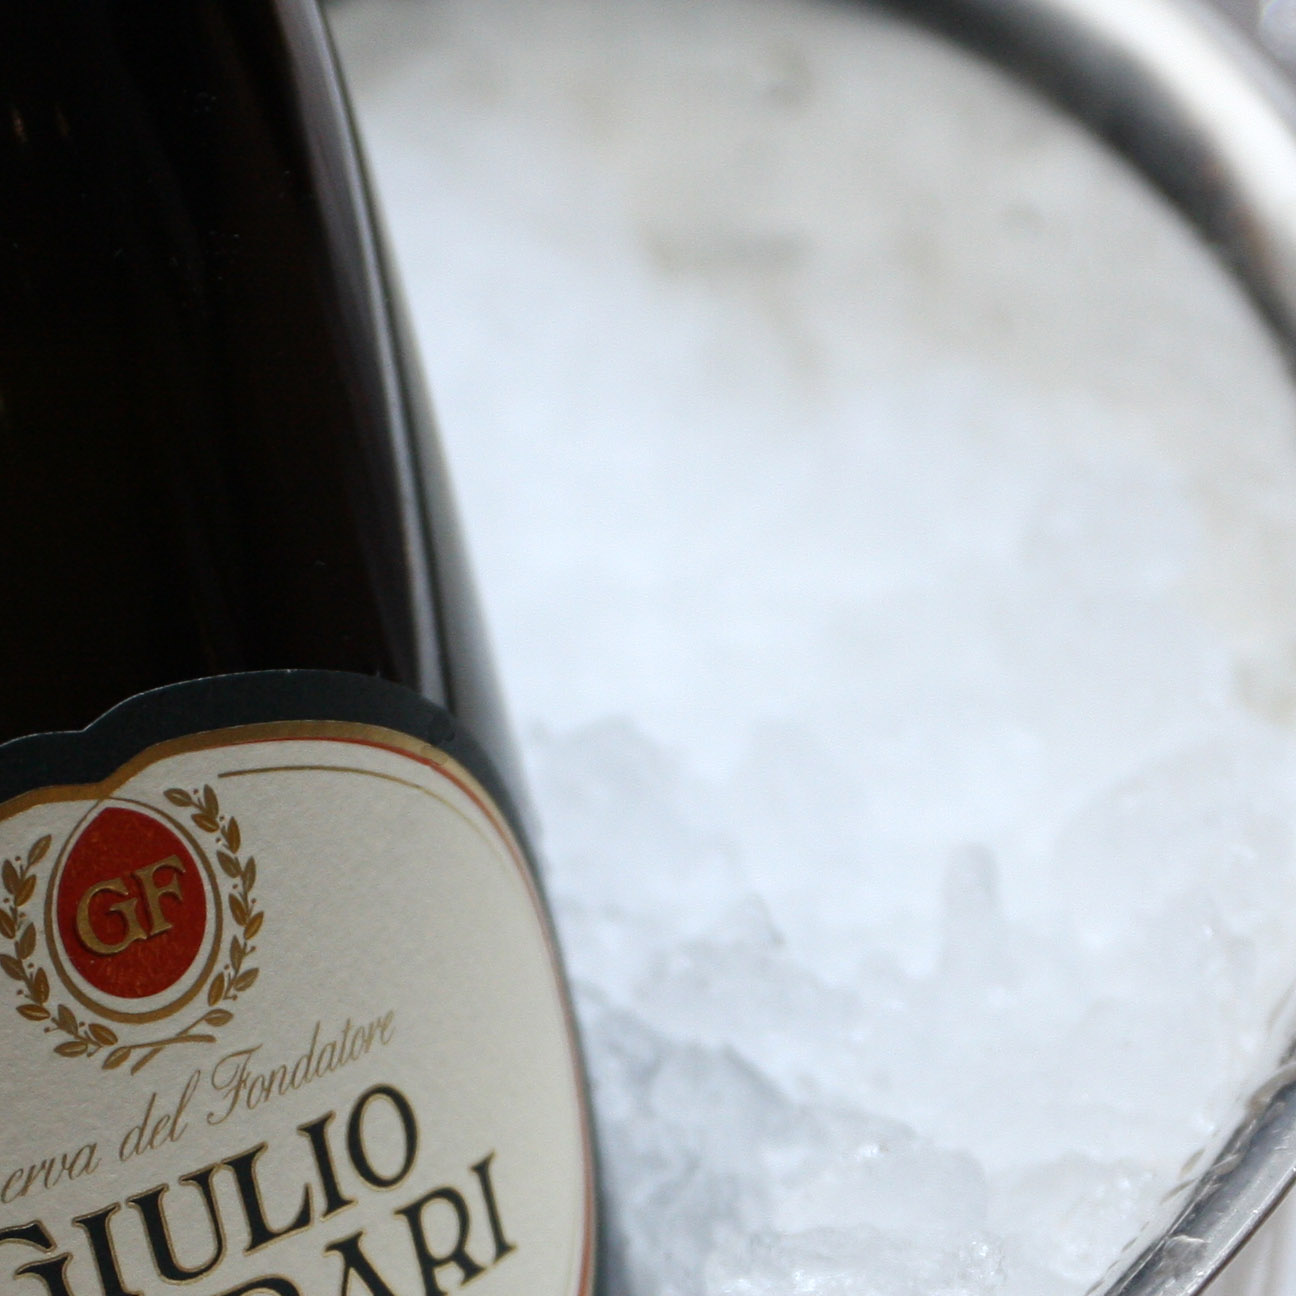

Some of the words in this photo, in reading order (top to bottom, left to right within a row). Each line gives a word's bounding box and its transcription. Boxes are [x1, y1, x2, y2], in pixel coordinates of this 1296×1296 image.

[77, 855, 186, 955] GF
[118, 1070, 201, 1162] del
[207, 1010, 396, 1125] Fondatore
